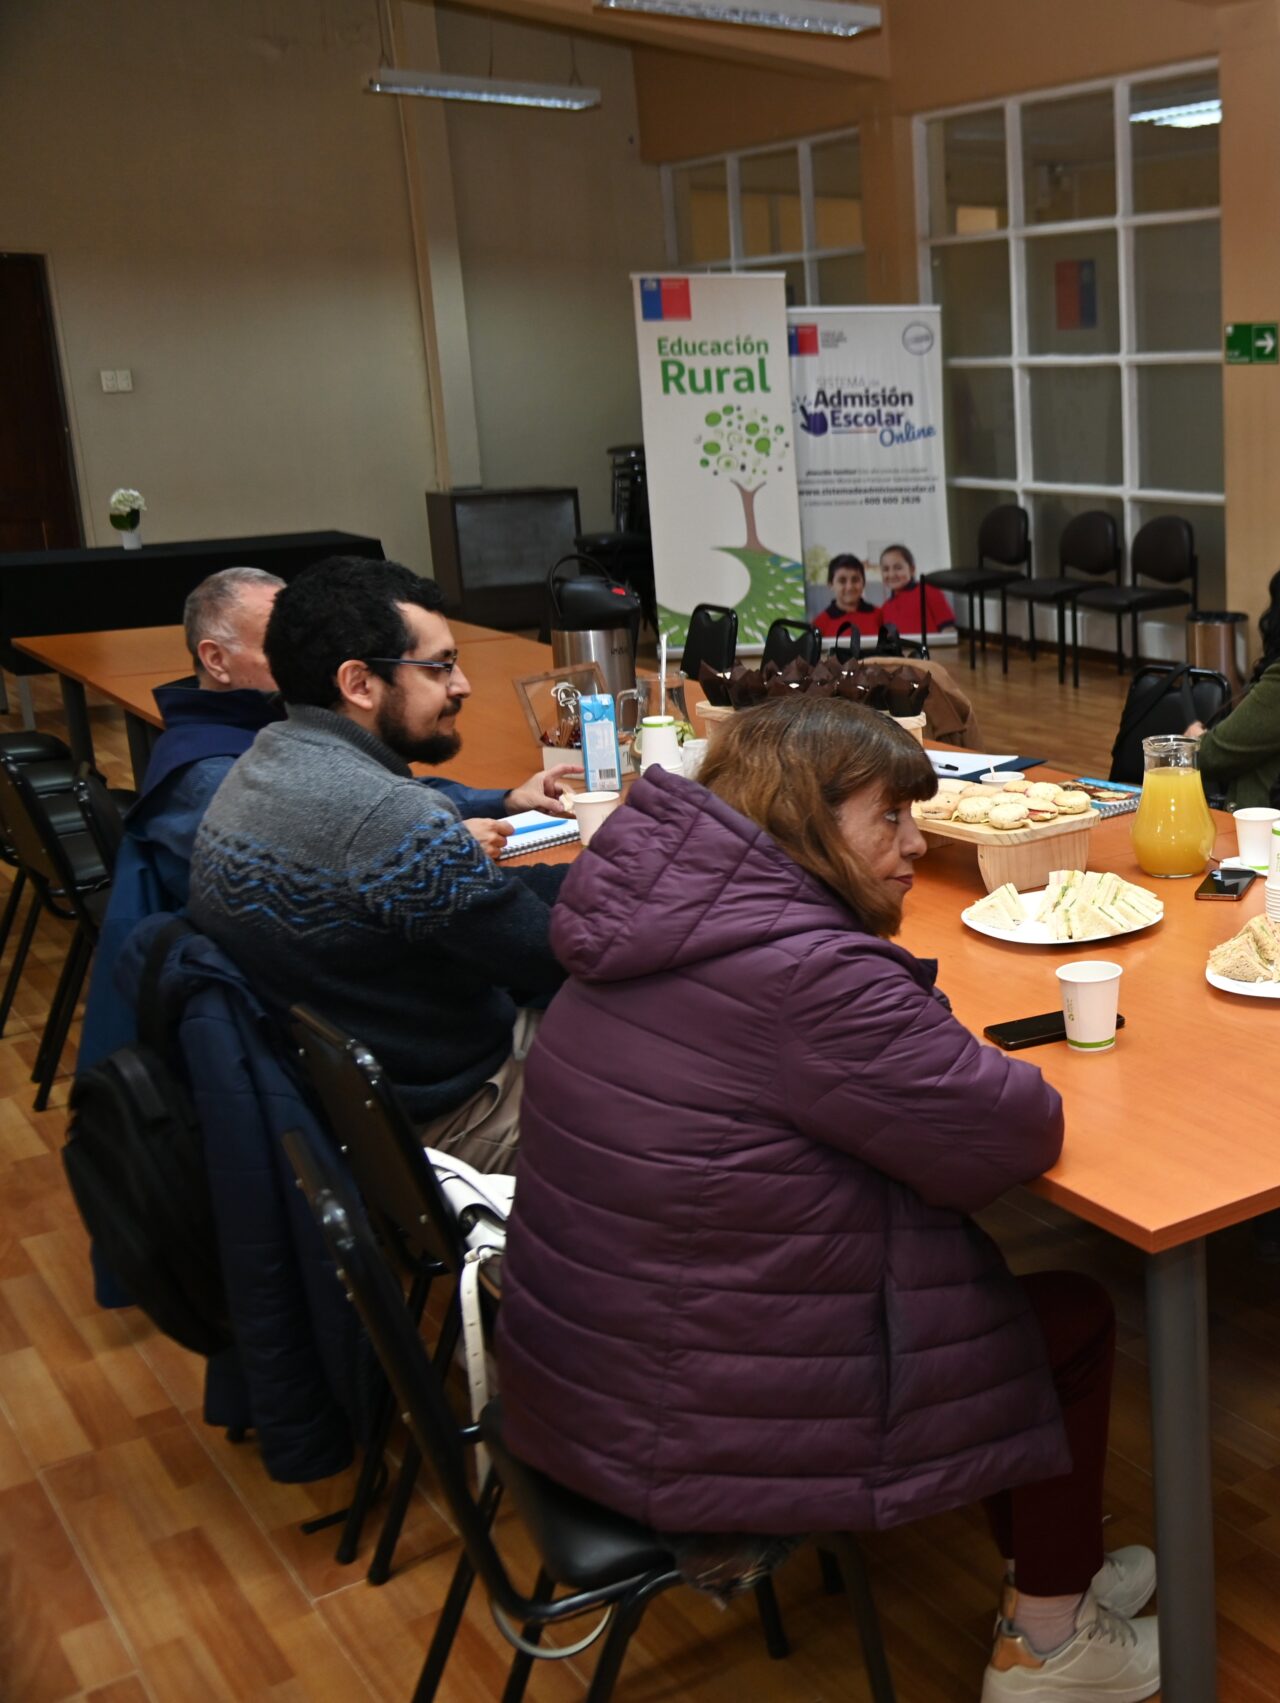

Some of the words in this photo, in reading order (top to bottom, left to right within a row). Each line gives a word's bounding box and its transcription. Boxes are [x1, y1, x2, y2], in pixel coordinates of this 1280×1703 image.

[657, 335, 769, 357] Educación
[661, 357, 772, 395] Rural
[814, 386, 914, 408] Admisión
[830, 408, 904, 428] Escolar
[879, 421, 936, 447] Online
